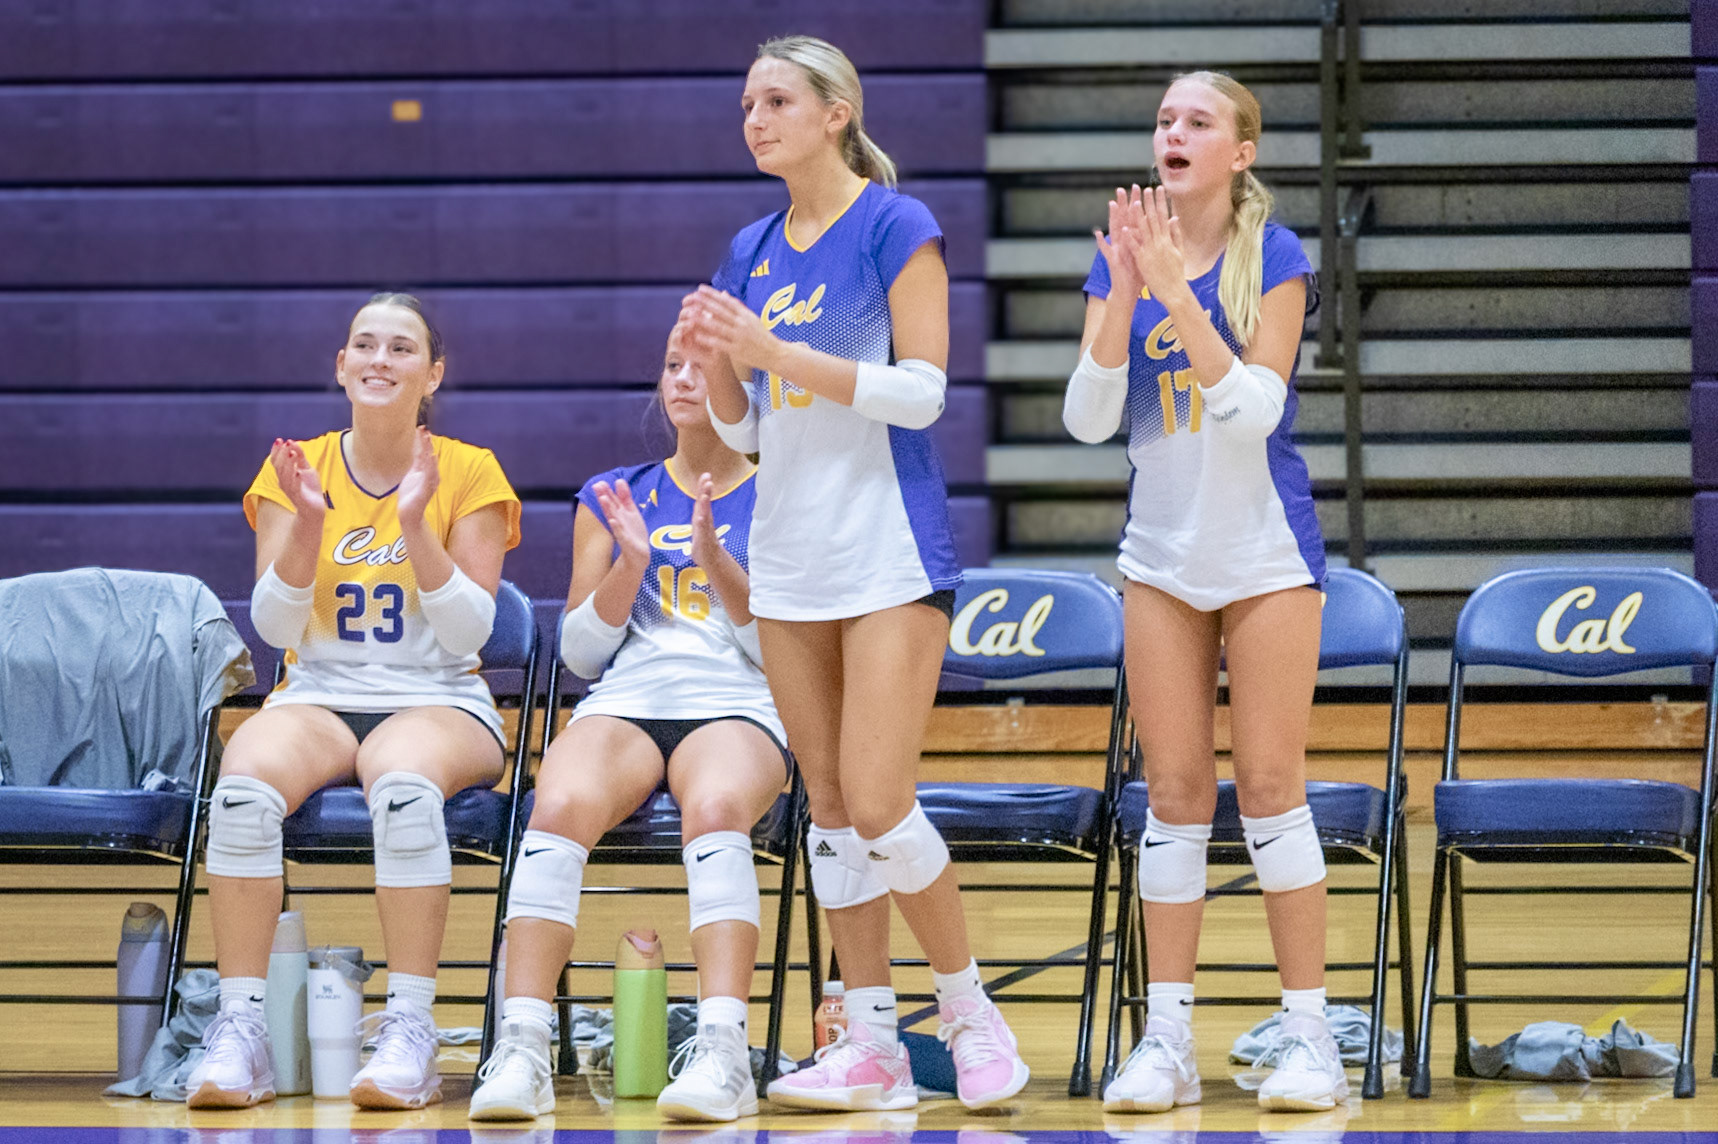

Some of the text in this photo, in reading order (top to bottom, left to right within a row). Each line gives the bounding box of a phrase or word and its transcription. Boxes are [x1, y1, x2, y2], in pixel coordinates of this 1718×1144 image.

[761, 282, 826, 330] Cal
[1157, 368, 1203, 435] 17
[335, 583, 404, 643] 23
[657, 565, 711, 621] 16
[949, 588, 1054, 657] Cal
[1536, 585, 1643, 654] Cal
